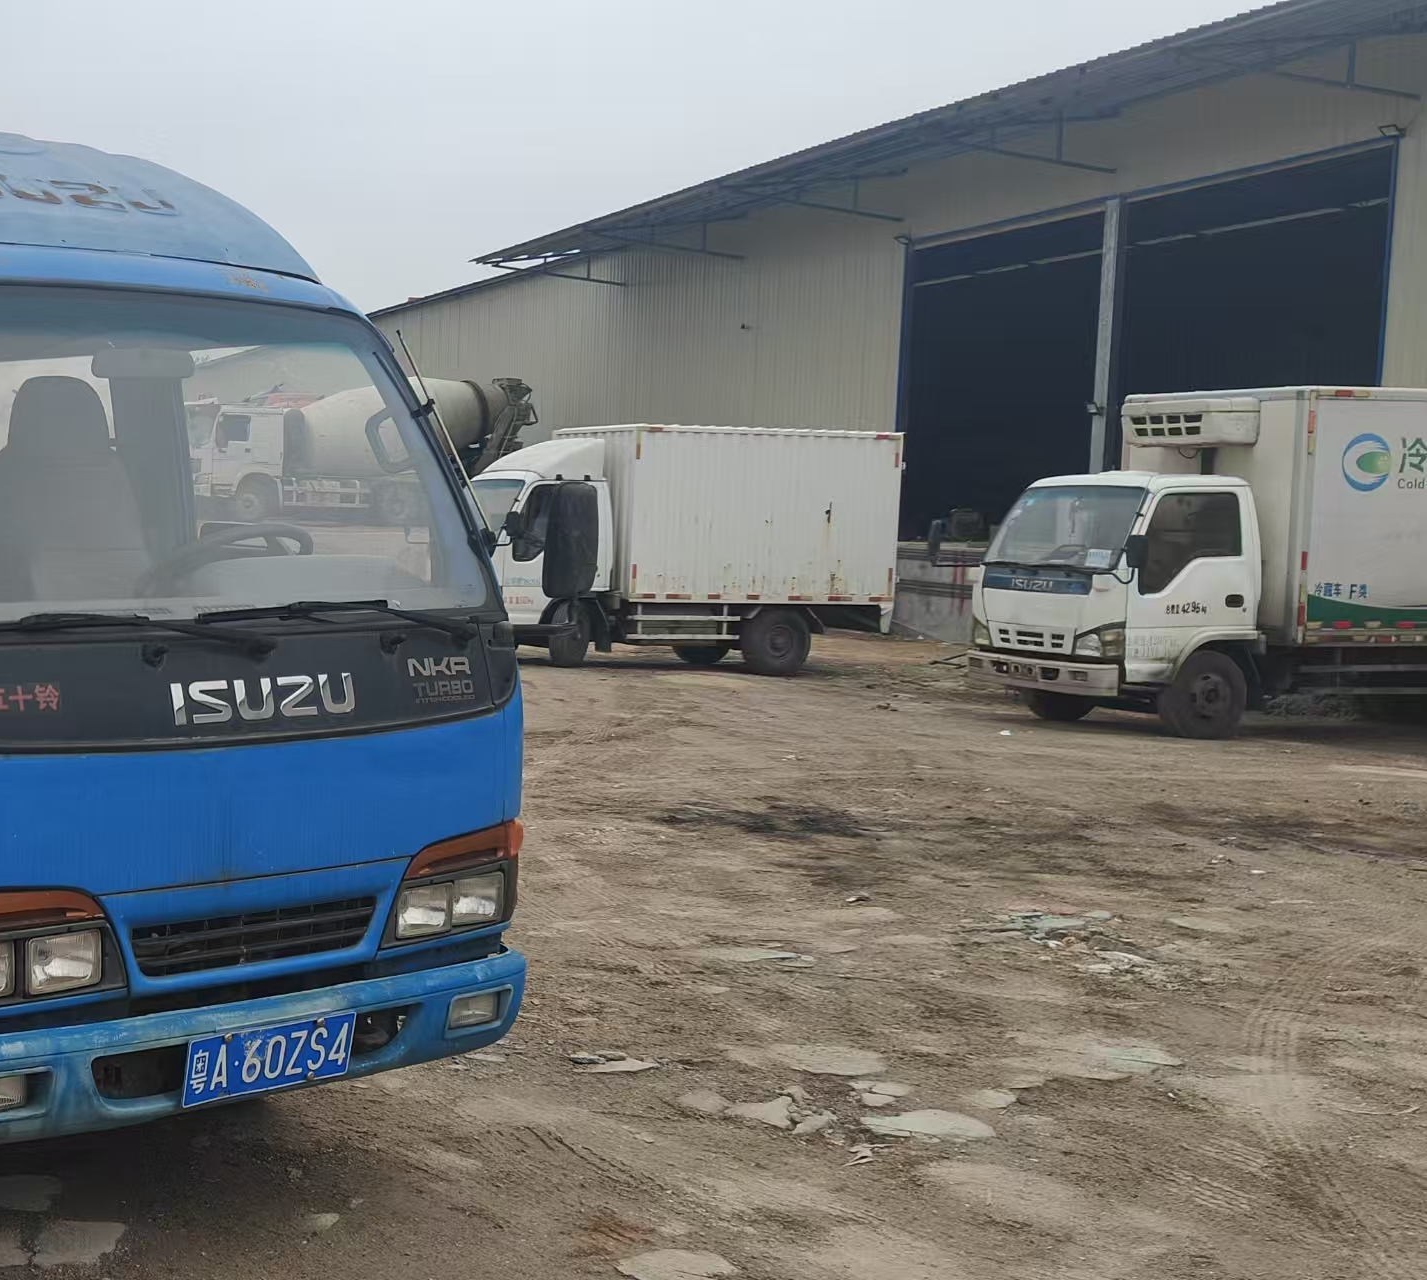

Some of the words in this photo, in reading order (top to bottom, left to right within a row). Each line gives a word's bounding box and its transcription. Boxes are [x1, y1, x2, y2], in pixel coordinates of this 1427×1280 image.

[1397, 478, 1425, 489] Cold
[1012, 578, 1053, 592] ISUZU
[407, 656, 471, 677] NKR
[413, 679, 474, 697] TURBO
[170, 672, 355, 726] ISUZU
